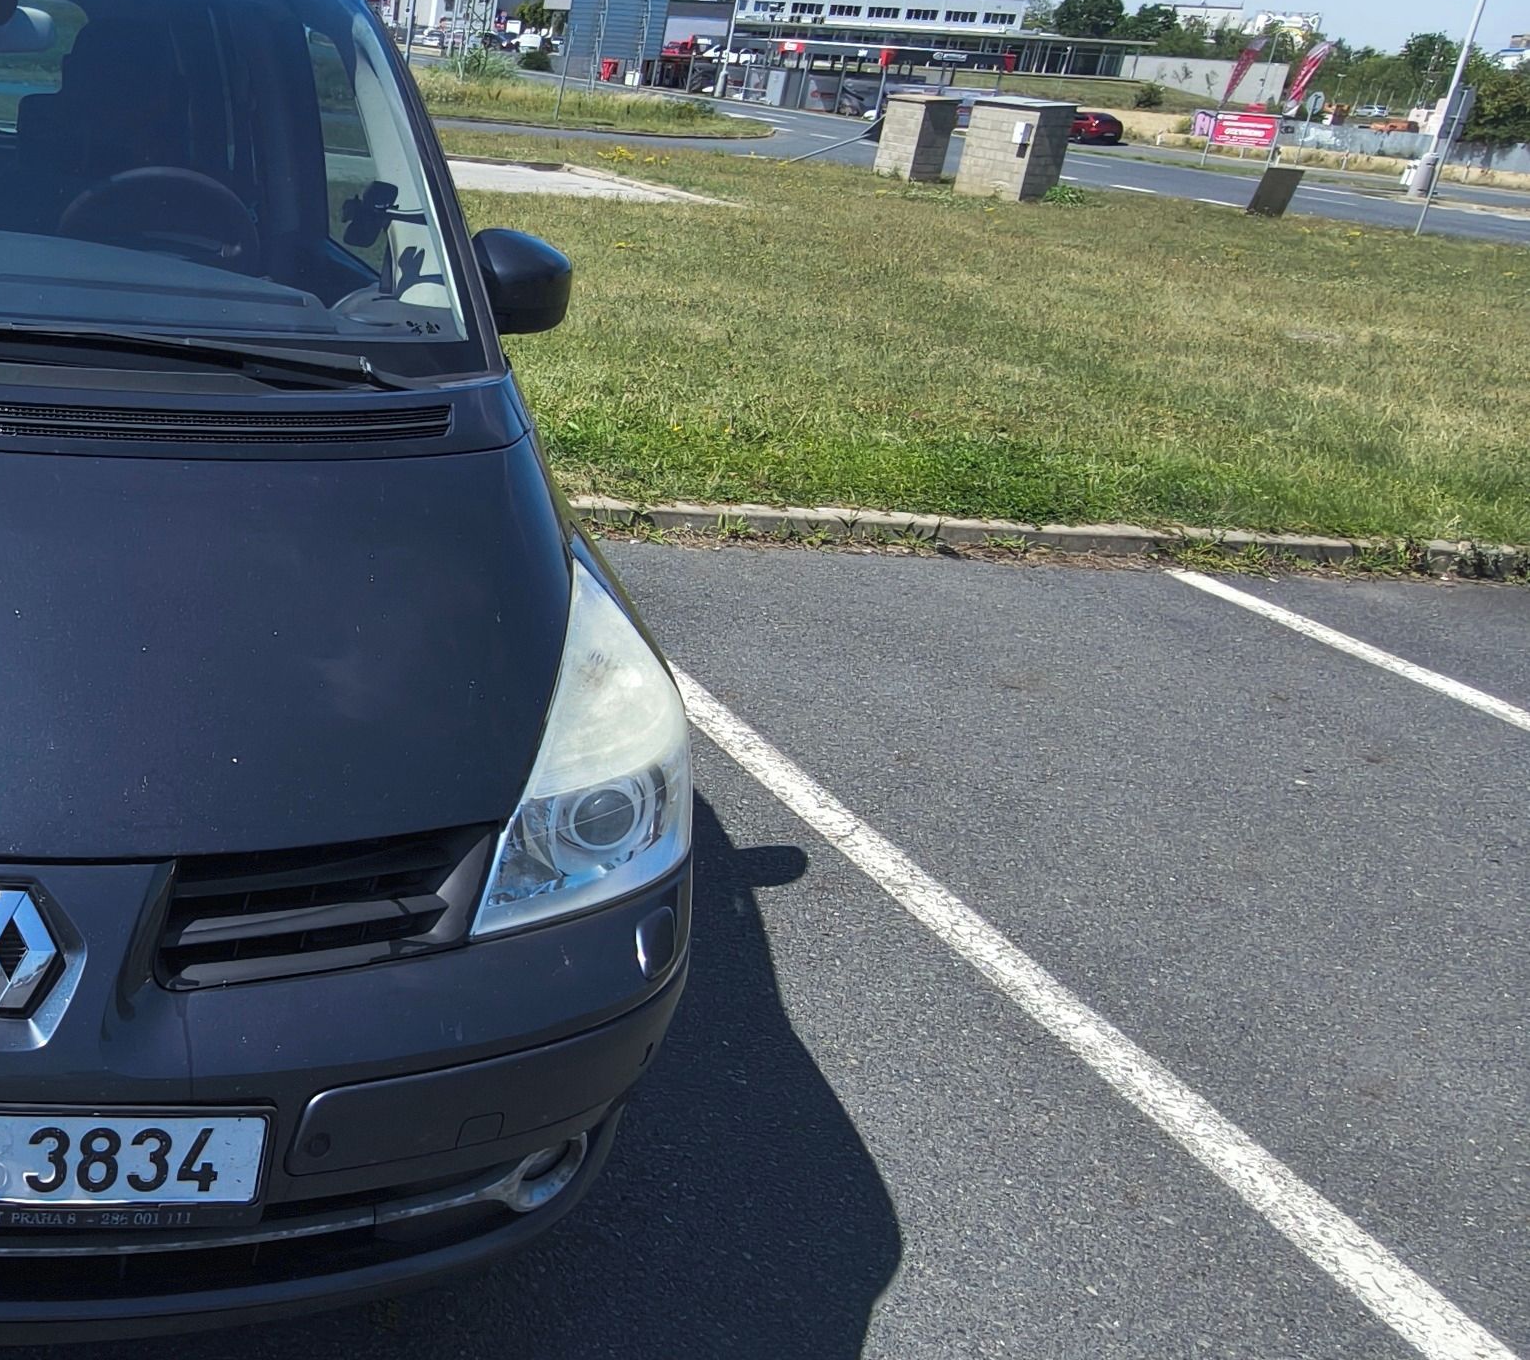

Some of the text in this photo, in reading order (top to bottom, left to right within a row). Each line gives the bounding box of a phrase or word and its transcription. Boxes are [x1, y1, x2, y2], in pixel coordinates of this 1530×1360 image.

[23, 1126, 218, 1193] 3834
[11, 1212, 63, 1225] PRAHA
[67, 1213, 76, 1225] 8
[133, 1212, 159, 1225] 001
